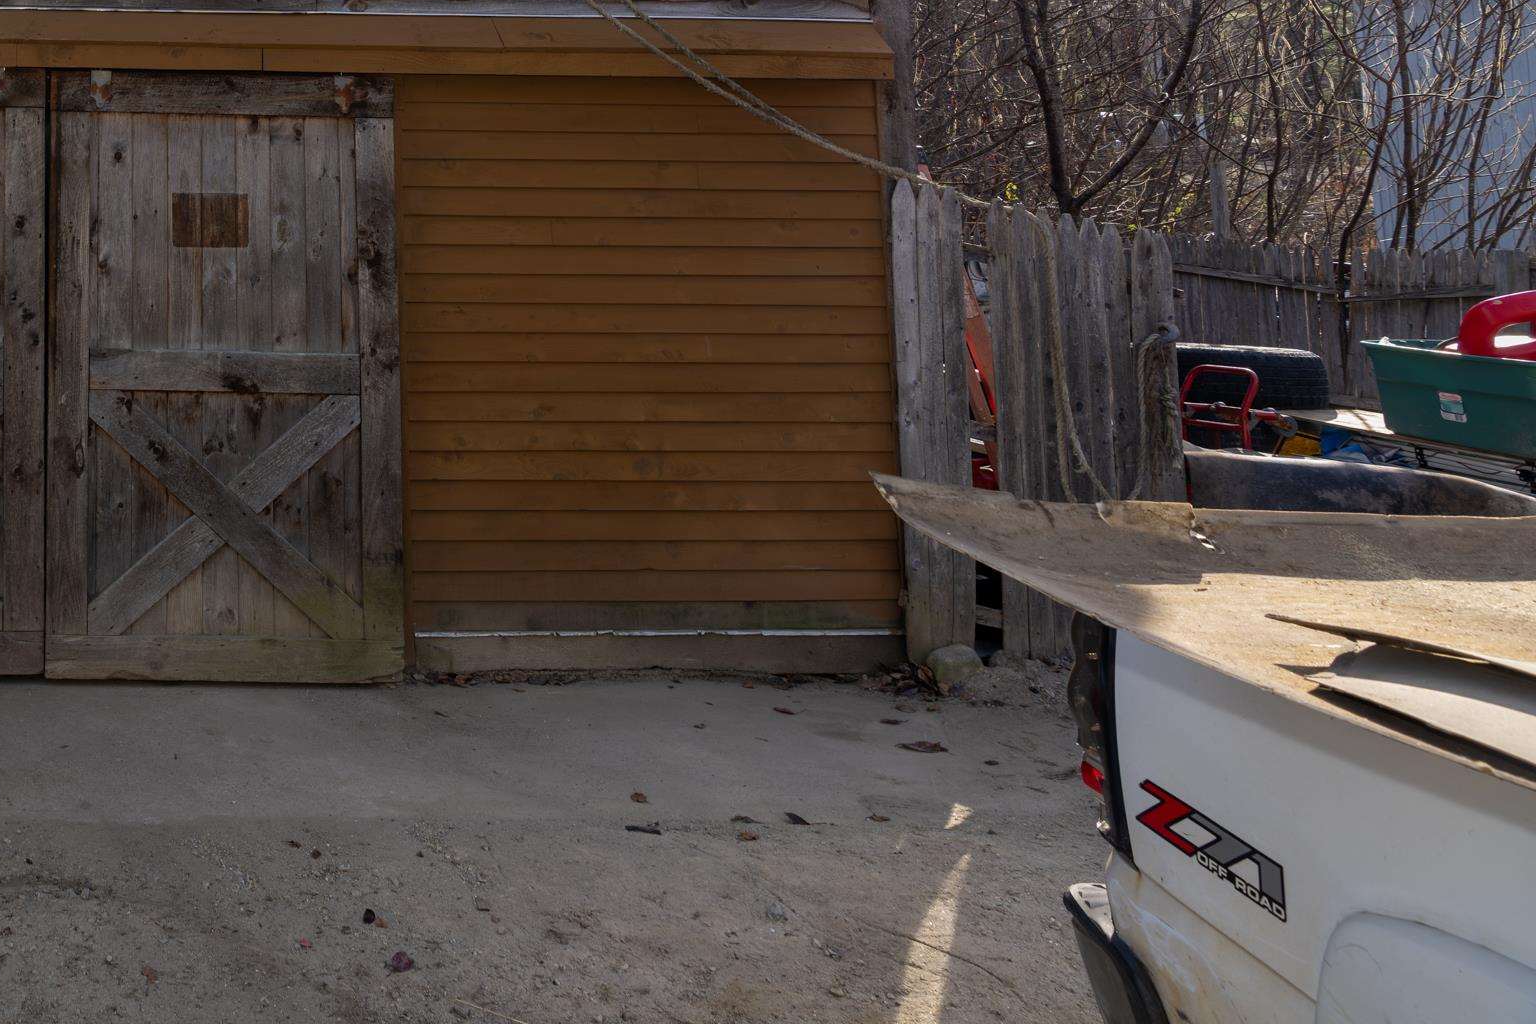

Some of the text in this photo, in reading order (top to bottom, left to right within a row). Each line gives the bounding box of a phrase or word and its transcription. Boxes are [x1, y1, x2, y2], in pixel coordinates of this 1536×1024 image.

[1135, 778, 1285, 905] Z71
[1196, 850, 1286, 921] OFF ROAD
